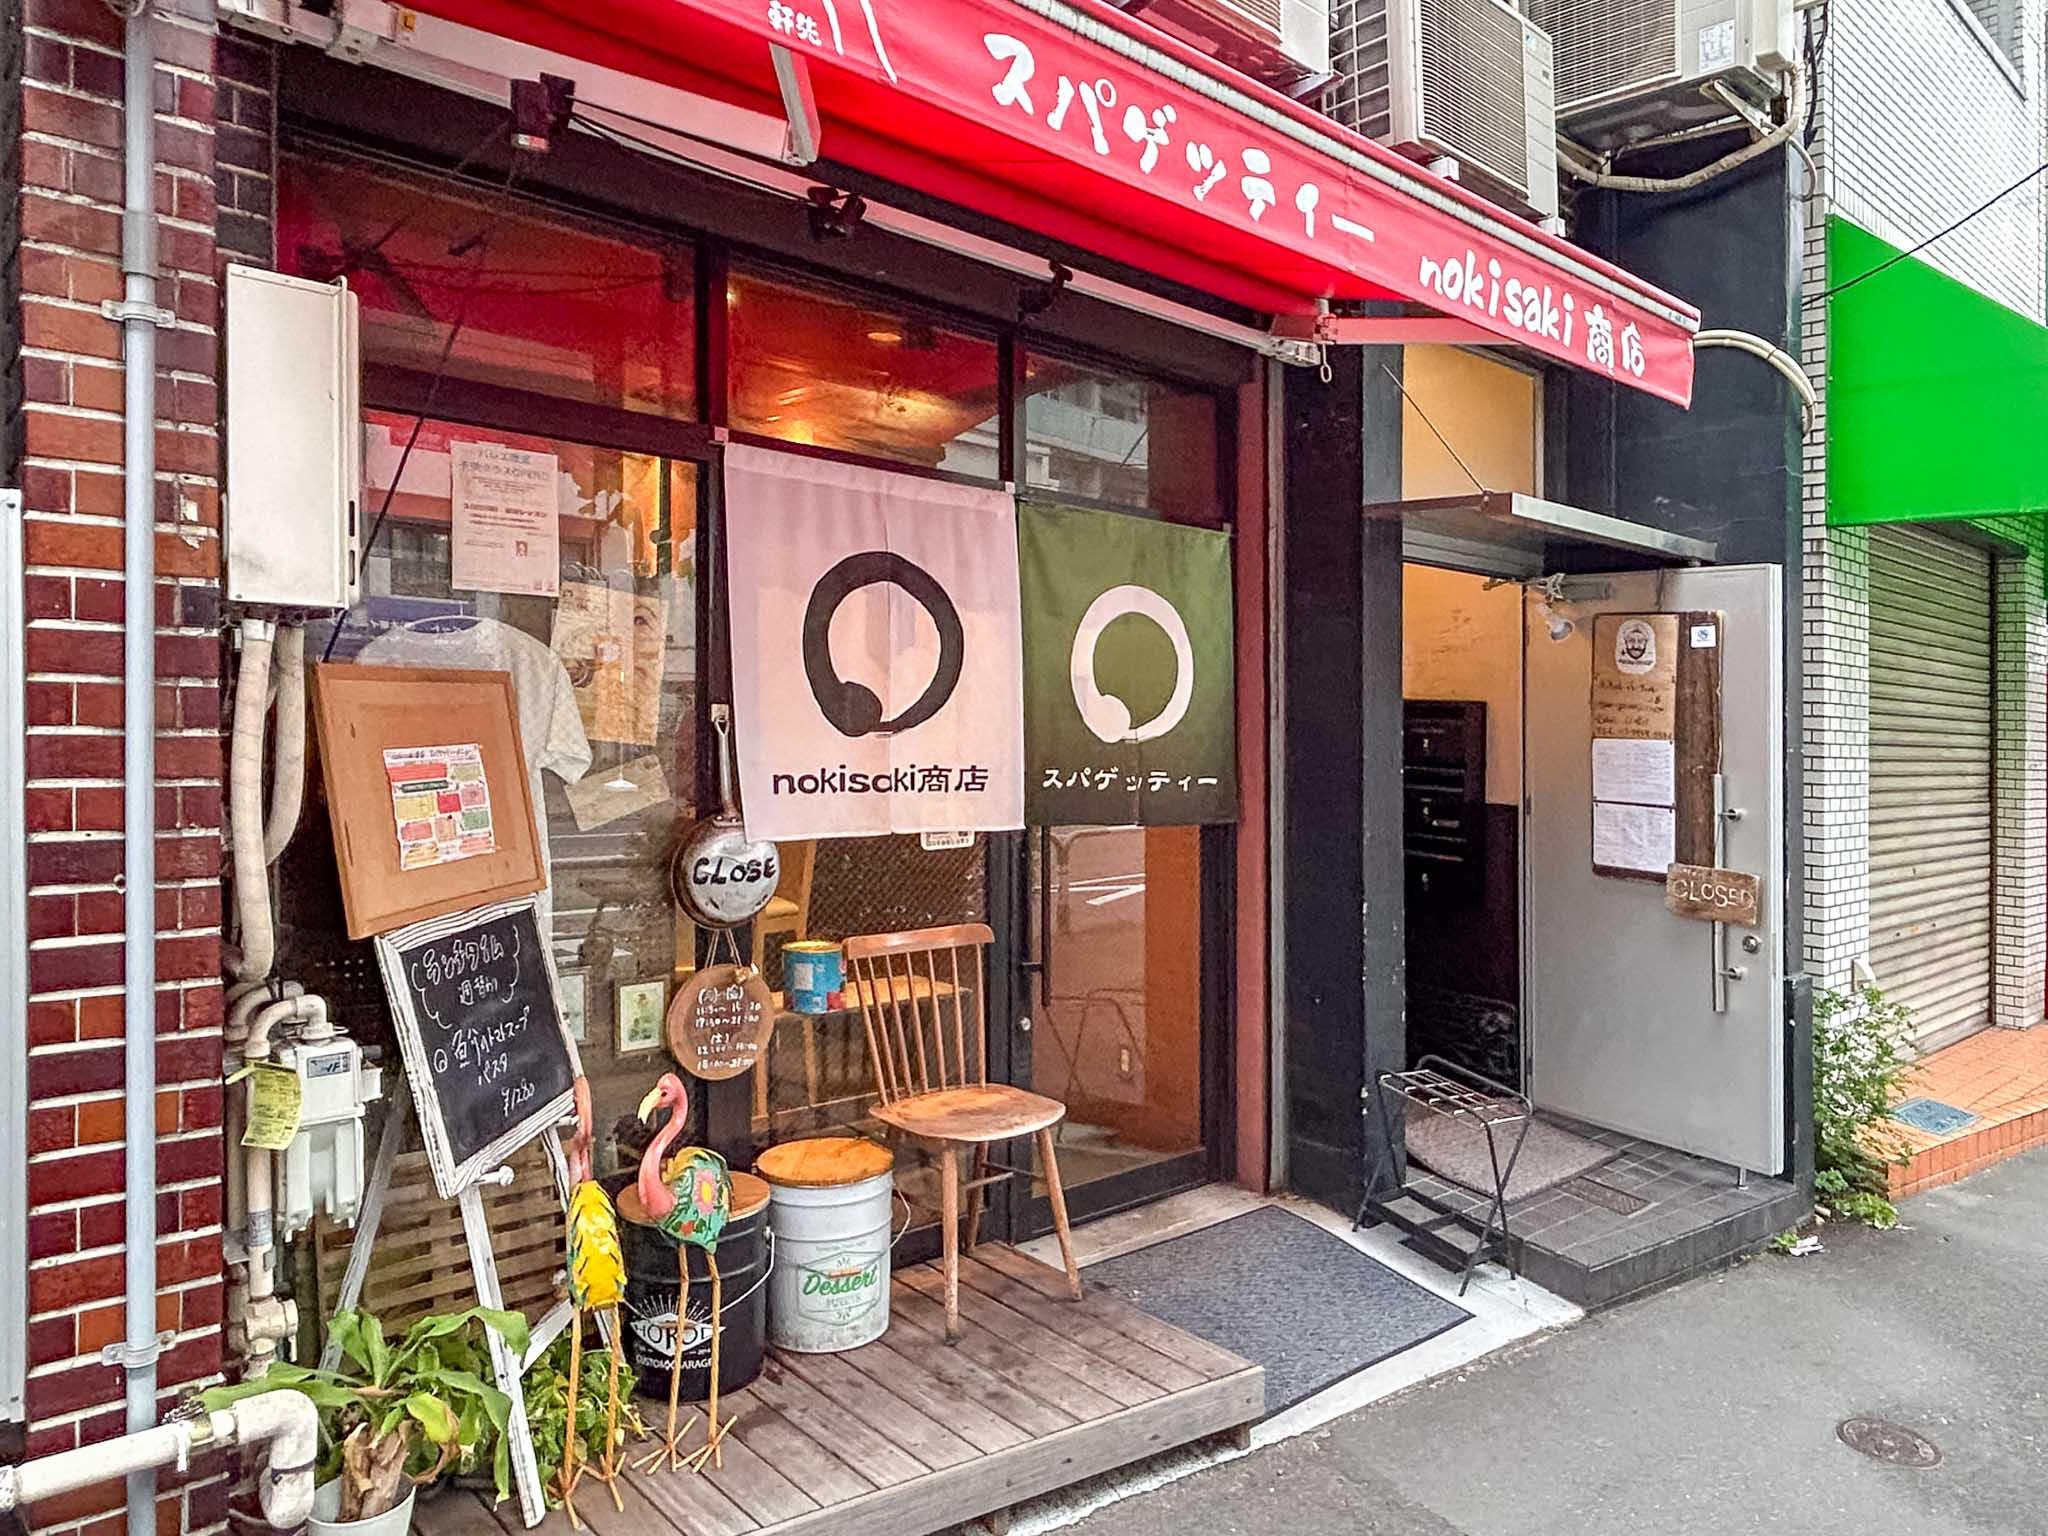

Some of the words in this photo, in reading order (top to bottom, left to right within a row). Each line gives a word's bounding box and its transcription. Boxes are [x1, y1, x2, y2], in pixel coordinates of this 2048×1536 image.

[983, 32, 1374, 242] スパゲッティー
[1419, 250, 1575, 348] nokisaki
[1584, 303, 1645, 377] 商店
[1042, 766, 1219, 793] スパゲッティー
[692, 856, 777, 885] CLOSE
[1673, 879, 1755, 911] CLOSED
[803, 1263, 878, 1295] Dessert
